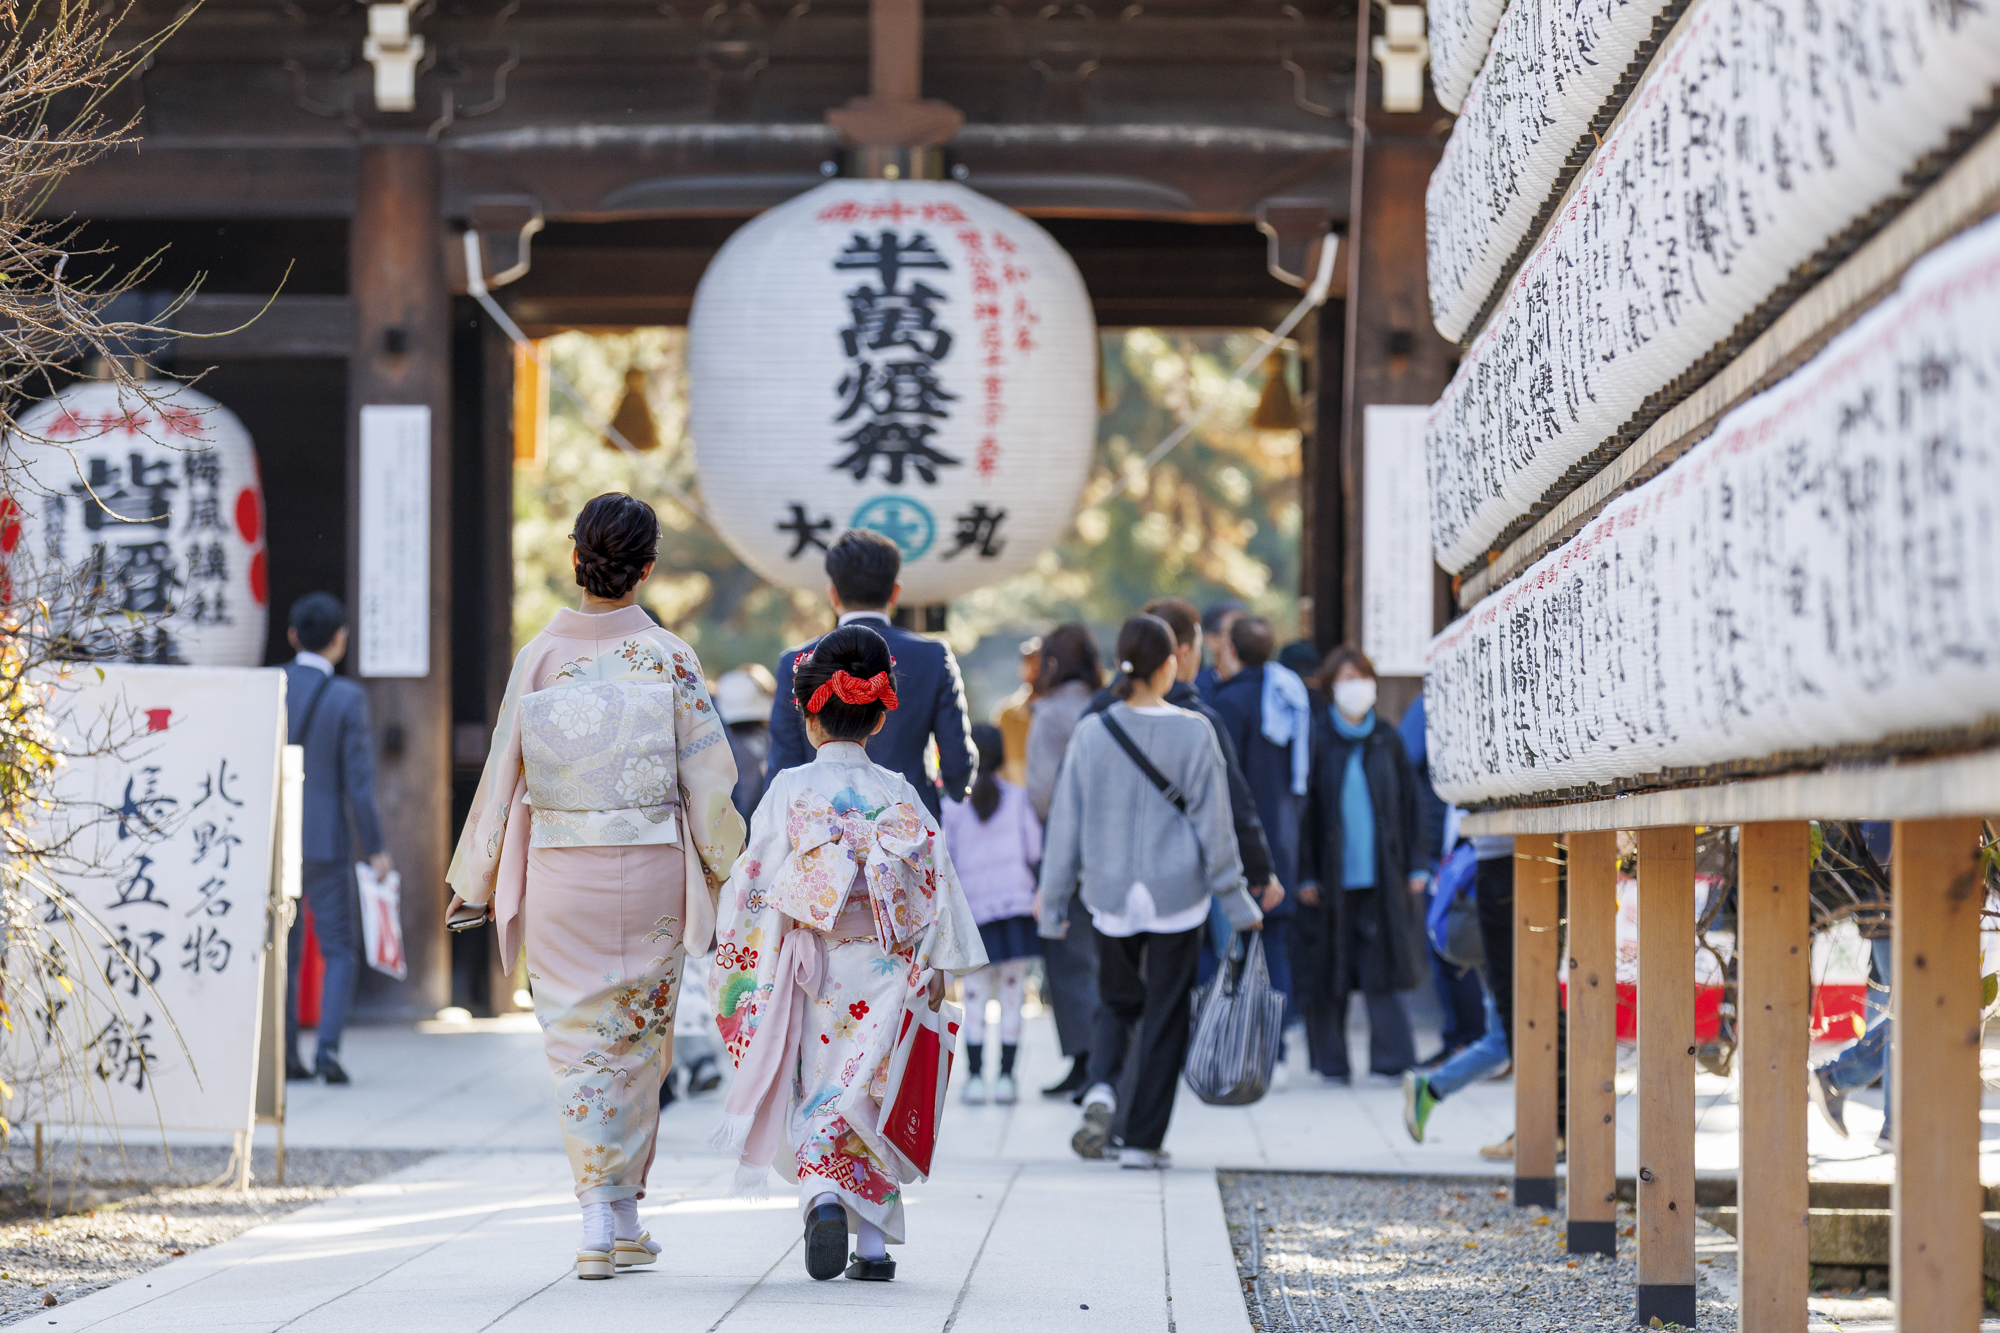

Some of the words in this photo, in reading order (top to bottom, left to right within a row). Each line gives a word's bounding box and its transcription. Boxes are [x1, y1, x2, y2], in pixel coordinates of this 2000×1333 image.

[833, 232, 960, 485] 半萬燈祭
[777, 503, 832, 559] 大
[940, 504, 1006, 560] 丸
[87, 764, 178, 1093] 長五郎餅
[181, 757, 244, 974] 北野名物
